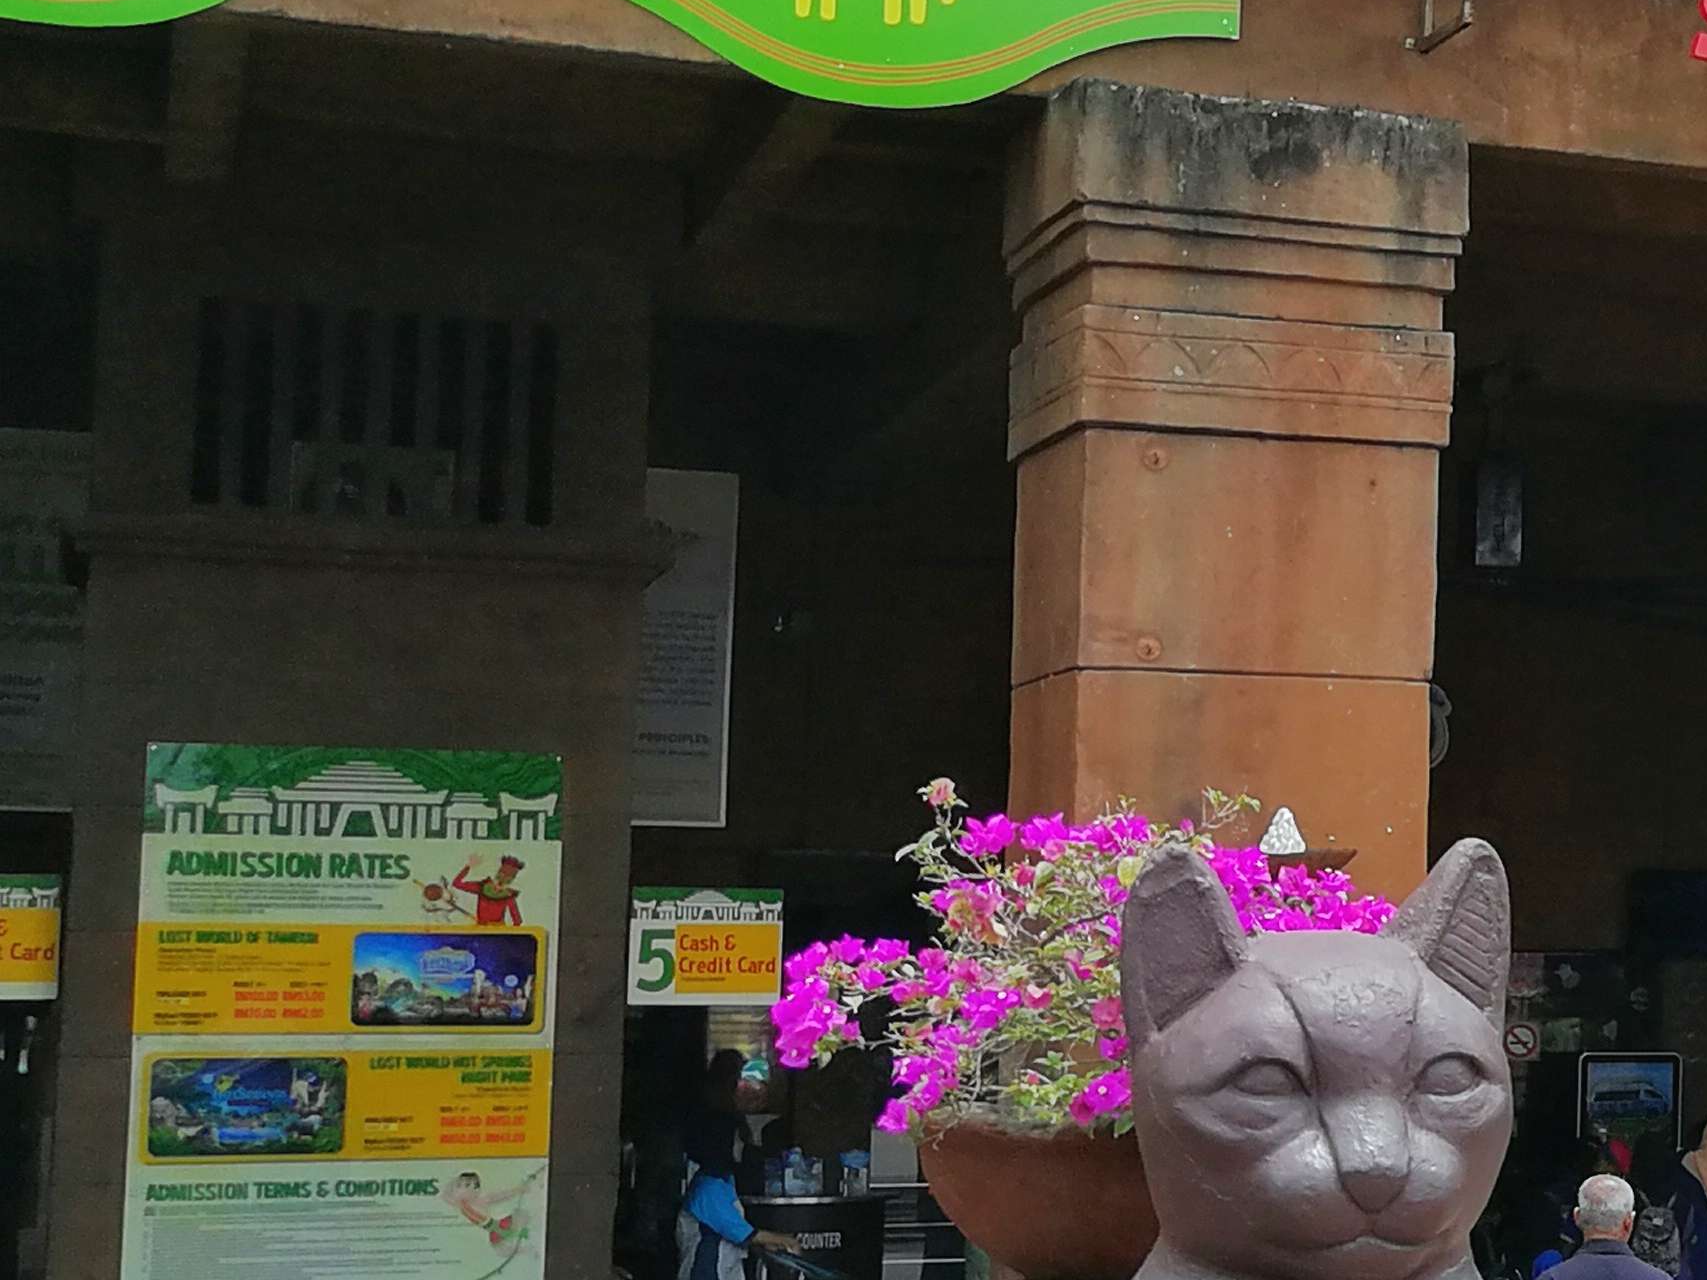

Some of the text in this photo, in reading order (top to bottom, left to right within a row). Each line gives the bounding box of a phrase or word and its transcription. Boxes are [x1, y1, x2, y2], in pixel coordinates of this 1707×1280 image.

[167, 849, 411, 880] ADMISSION RATES
[10, 943, 55, 961] Card
[679, 934, 719, 952] Cash
[636, 929, 675, 993] 5
[679, 956, 776, 974] Credit Card
[145, 1182, 249, 1201] ADMISSION
[253, 1181, 310, 1199] TERMS
[335, 1179, 440, 1198] CONDITIONS
